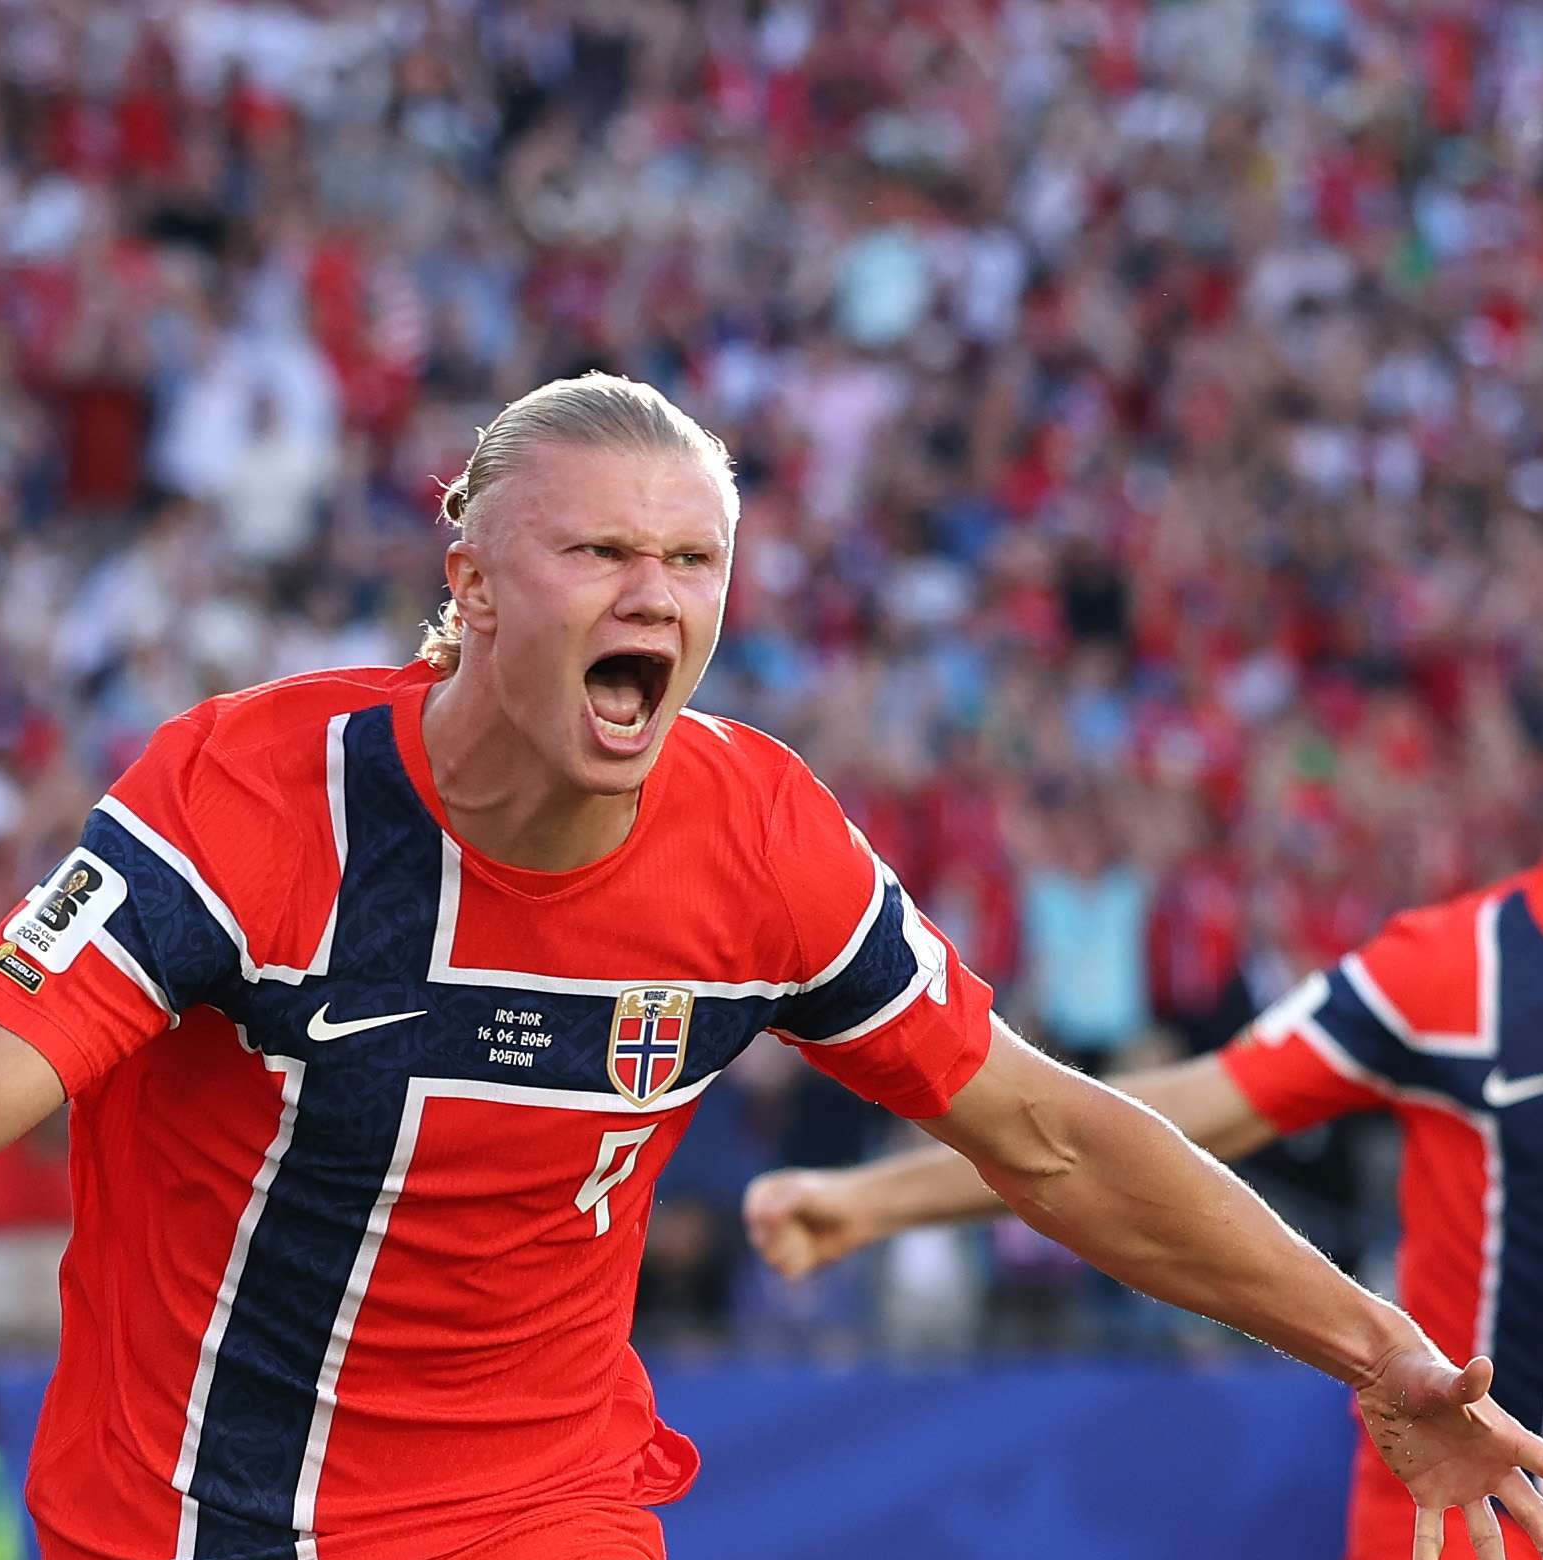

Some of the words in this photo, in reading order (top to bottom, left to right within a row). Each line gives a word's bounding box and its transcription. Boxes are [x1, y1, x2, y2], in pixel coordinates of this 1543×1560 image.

[40, 907, 58, 924] FIFA
[17, 926, 51, 953] 2026
[5, 956, 40, 982] DEBUT
[495, 1008, 543, 1027] IRQ-NOR
[520, 1031, 553, 1048] 2026
[488, 1047, 534, 1067] BOSTON
[574, 1122, 659, 1238] 9
